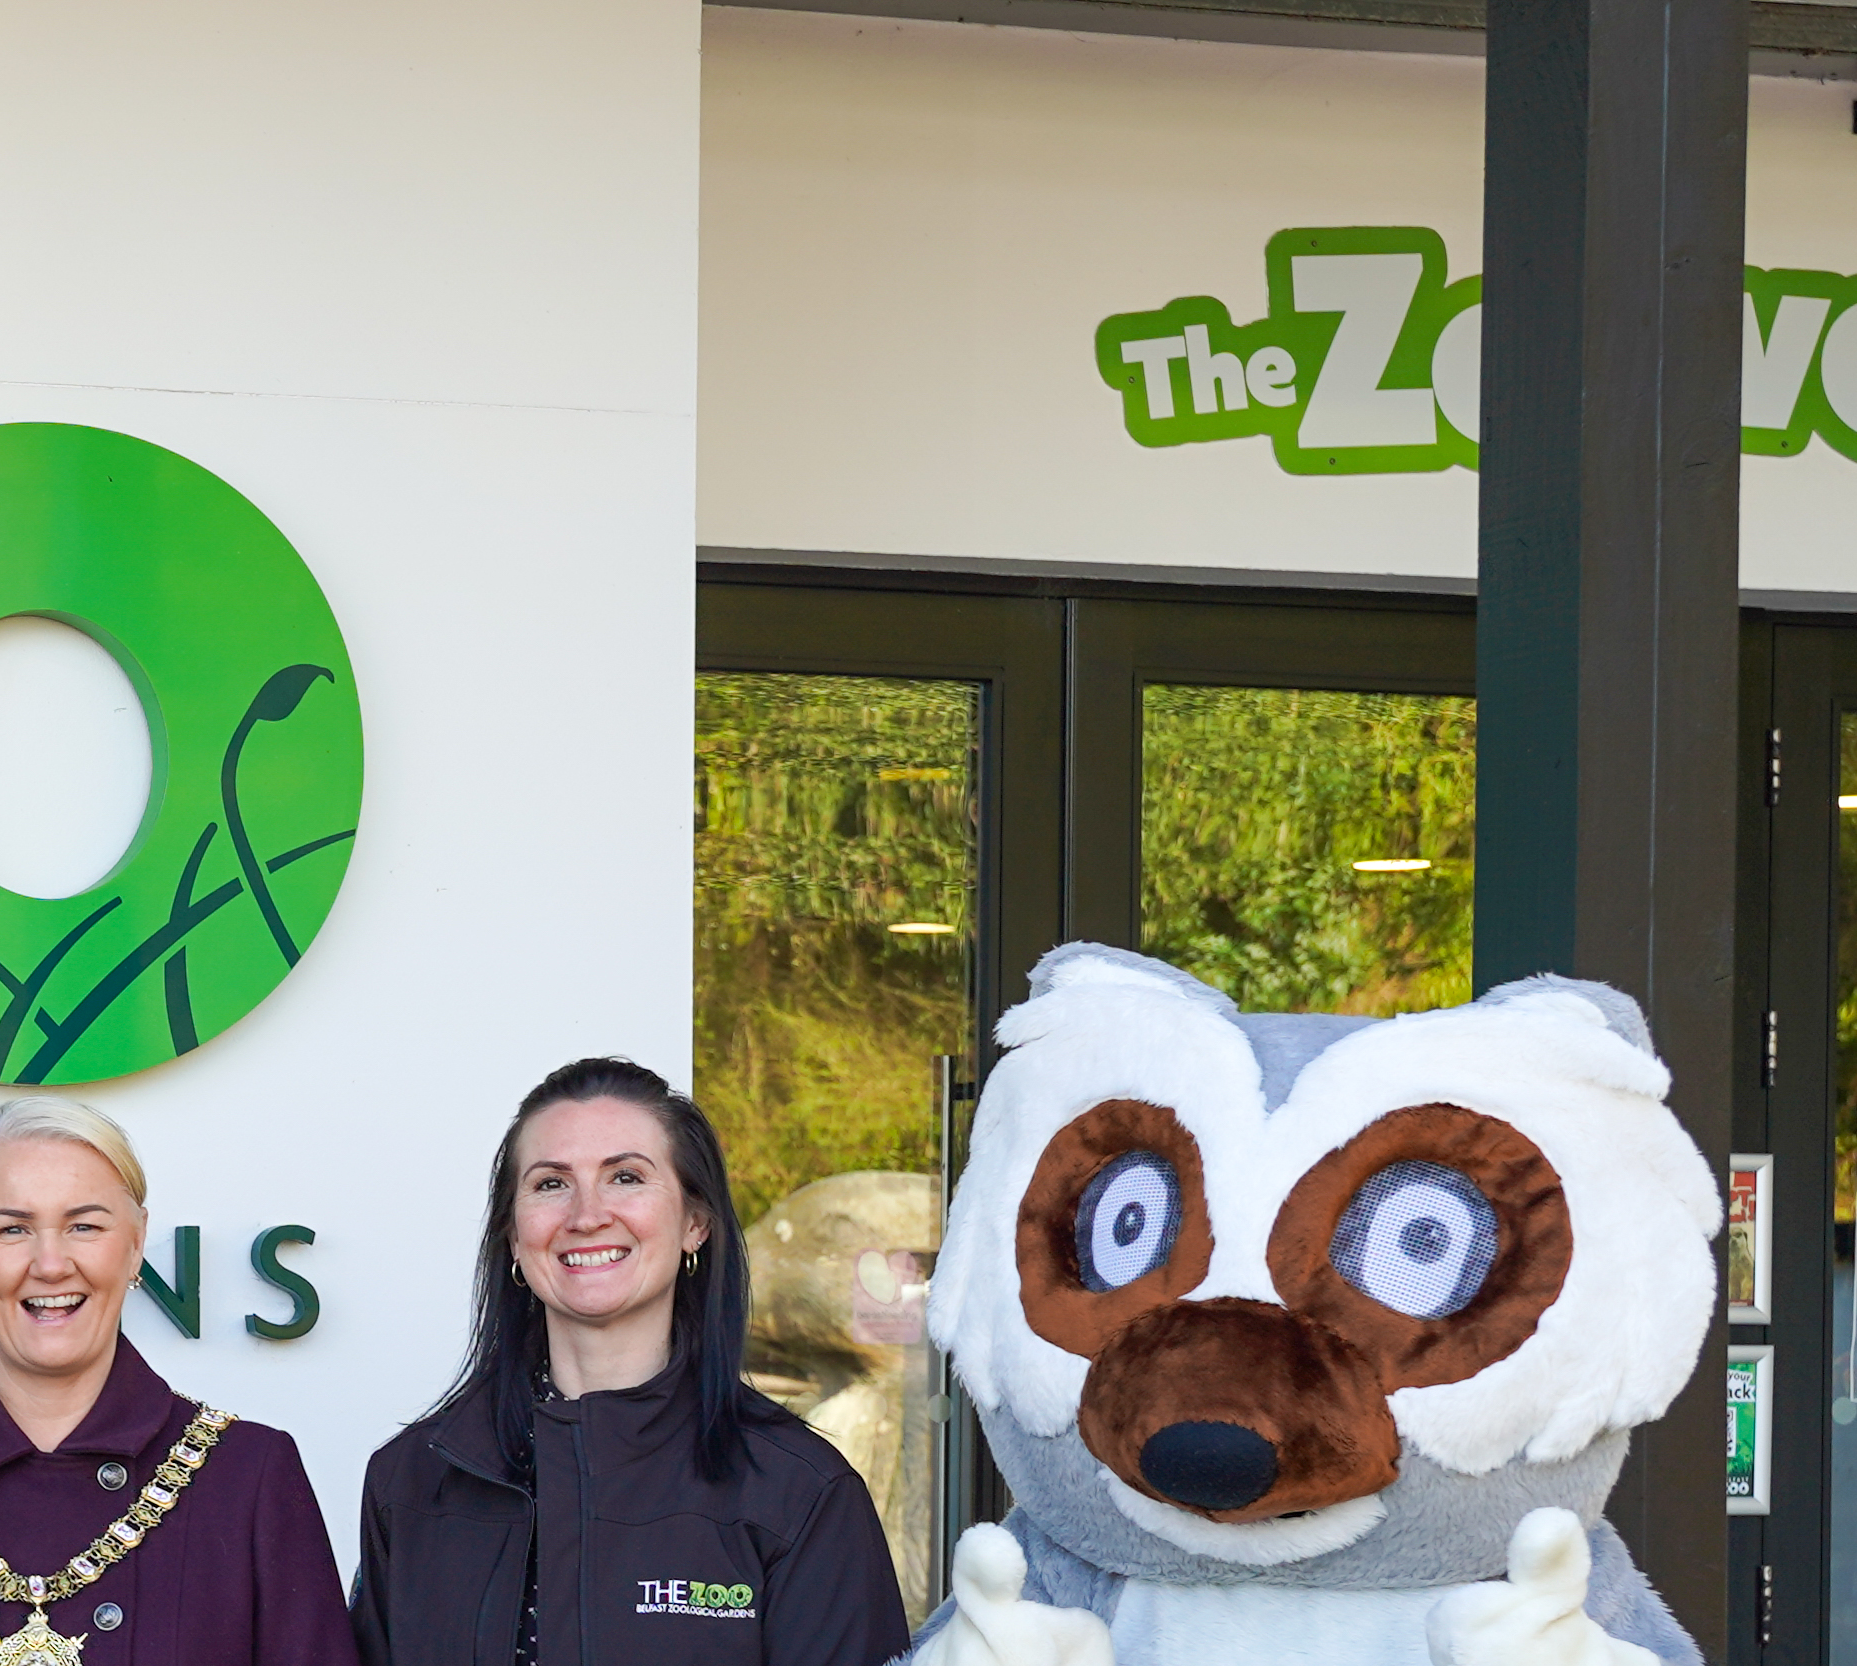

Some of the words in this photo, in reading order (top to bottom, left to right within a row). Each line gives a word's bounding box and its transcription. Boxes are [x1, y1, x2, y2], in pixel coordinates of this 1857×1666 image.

[1121, 324, 1297, 421] The
[1726, 1481, 1750, 1495] OO
[637, 1580, 687, 1604] THE
[689, 1581, 753, 1608] ZOO
[636, 1604, 666, 1614] BELFAST
[668, 1604, 717, 1618] ZOOLOGICAL
[717, 1608, 756, 1619] GARDENS
